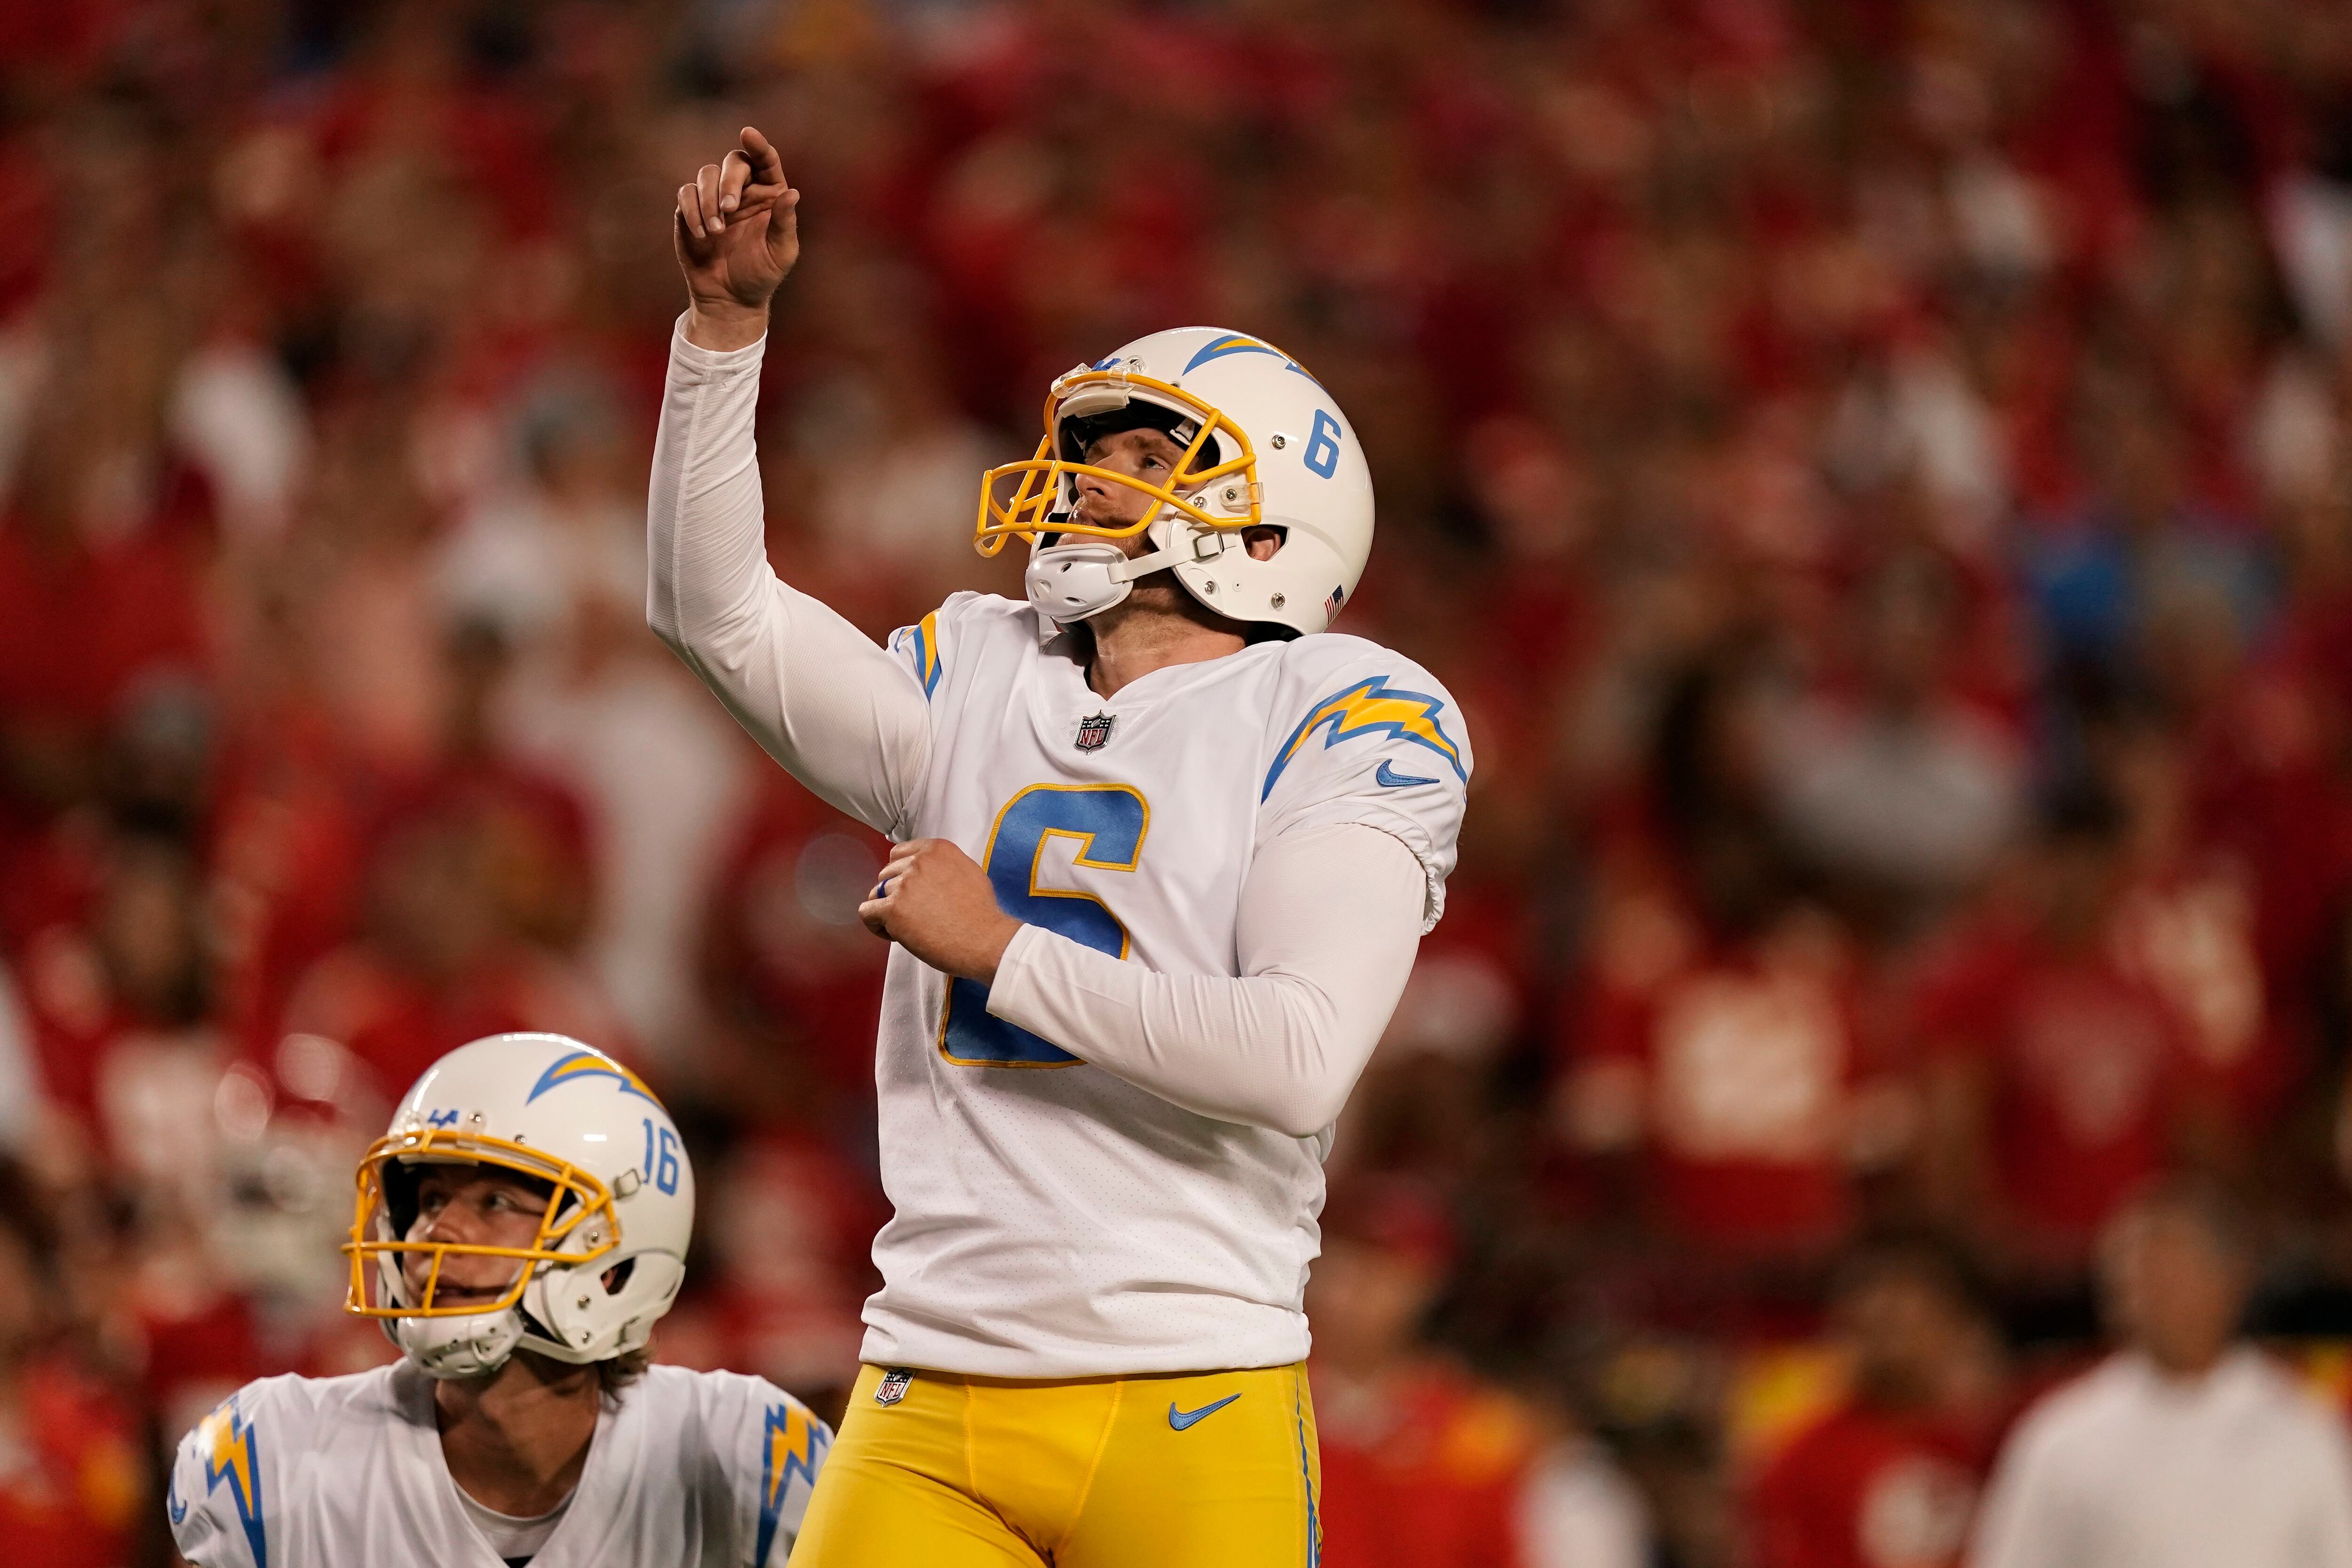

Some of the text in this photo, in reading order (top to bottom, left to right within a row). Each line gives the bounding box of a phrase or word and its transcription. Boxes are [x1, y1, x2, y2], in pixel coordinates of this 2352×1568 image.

[1303, 409, 1342, 479] 6
[1079, 729, 1103, 746] NFL
[938, 783, 1151, 1069] 6
[643, 1118, 678, 1195] 16
[880, 1383, 901, 1399] NFL
